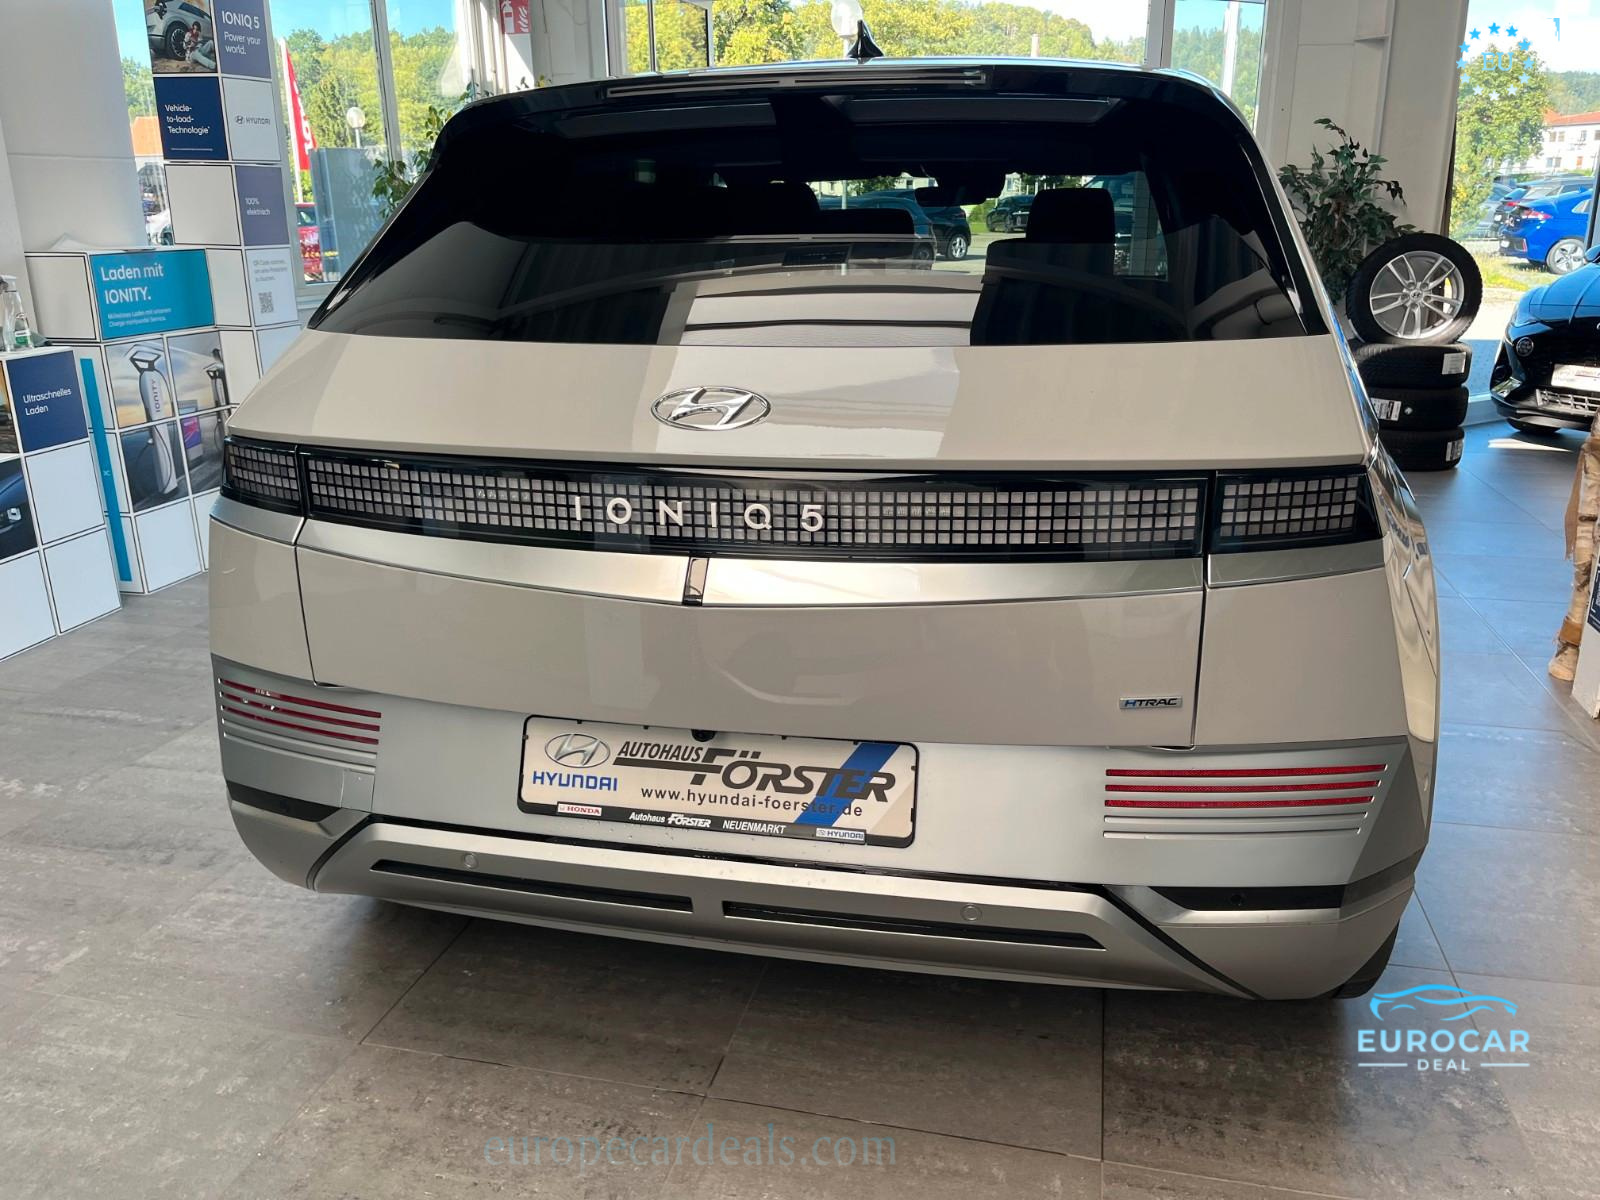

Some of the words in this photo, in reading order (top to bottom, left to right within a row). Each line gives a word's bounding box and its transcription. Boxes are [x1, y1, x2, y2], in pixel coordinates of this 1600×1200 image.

[222, 10, 252, 29] IONIQ
[254, 17, 260, 29] 5
[224, 31, 246, 43] Power
[247, 36, 261, 46] your
[225, 45, 247, 55] world.
[164, 104, 192, 112] Vehicle-
[166, 115, 194, 123] to-load-
[246, 116, 271, 126] HYUNDAI
[100, 264, 142, 282] Laden
[143, 263, 164, 278] mit
[104, 286, 152, 305] IONITY.
[22, 387, 72, 404] Ultraschnelles
[25, 404, 49, 416] Laden
[617, 740, 703, 763] AUTOHAUS
[690, 747, 896, 803] FÖRSTER
[532, 770, 618, 792] HYUNDAI
[566, 805, 601, 815] HONDA
[641, 787, 863, 817] www.hyundai-foerster.de
[629, 811, 666, 823] Autohaus
[667, 813, 712, 828] FÖRSTER
[722, 819, 787, 835] NEUENMARKT
[826, 830, 864, 841] HYUNDAI
